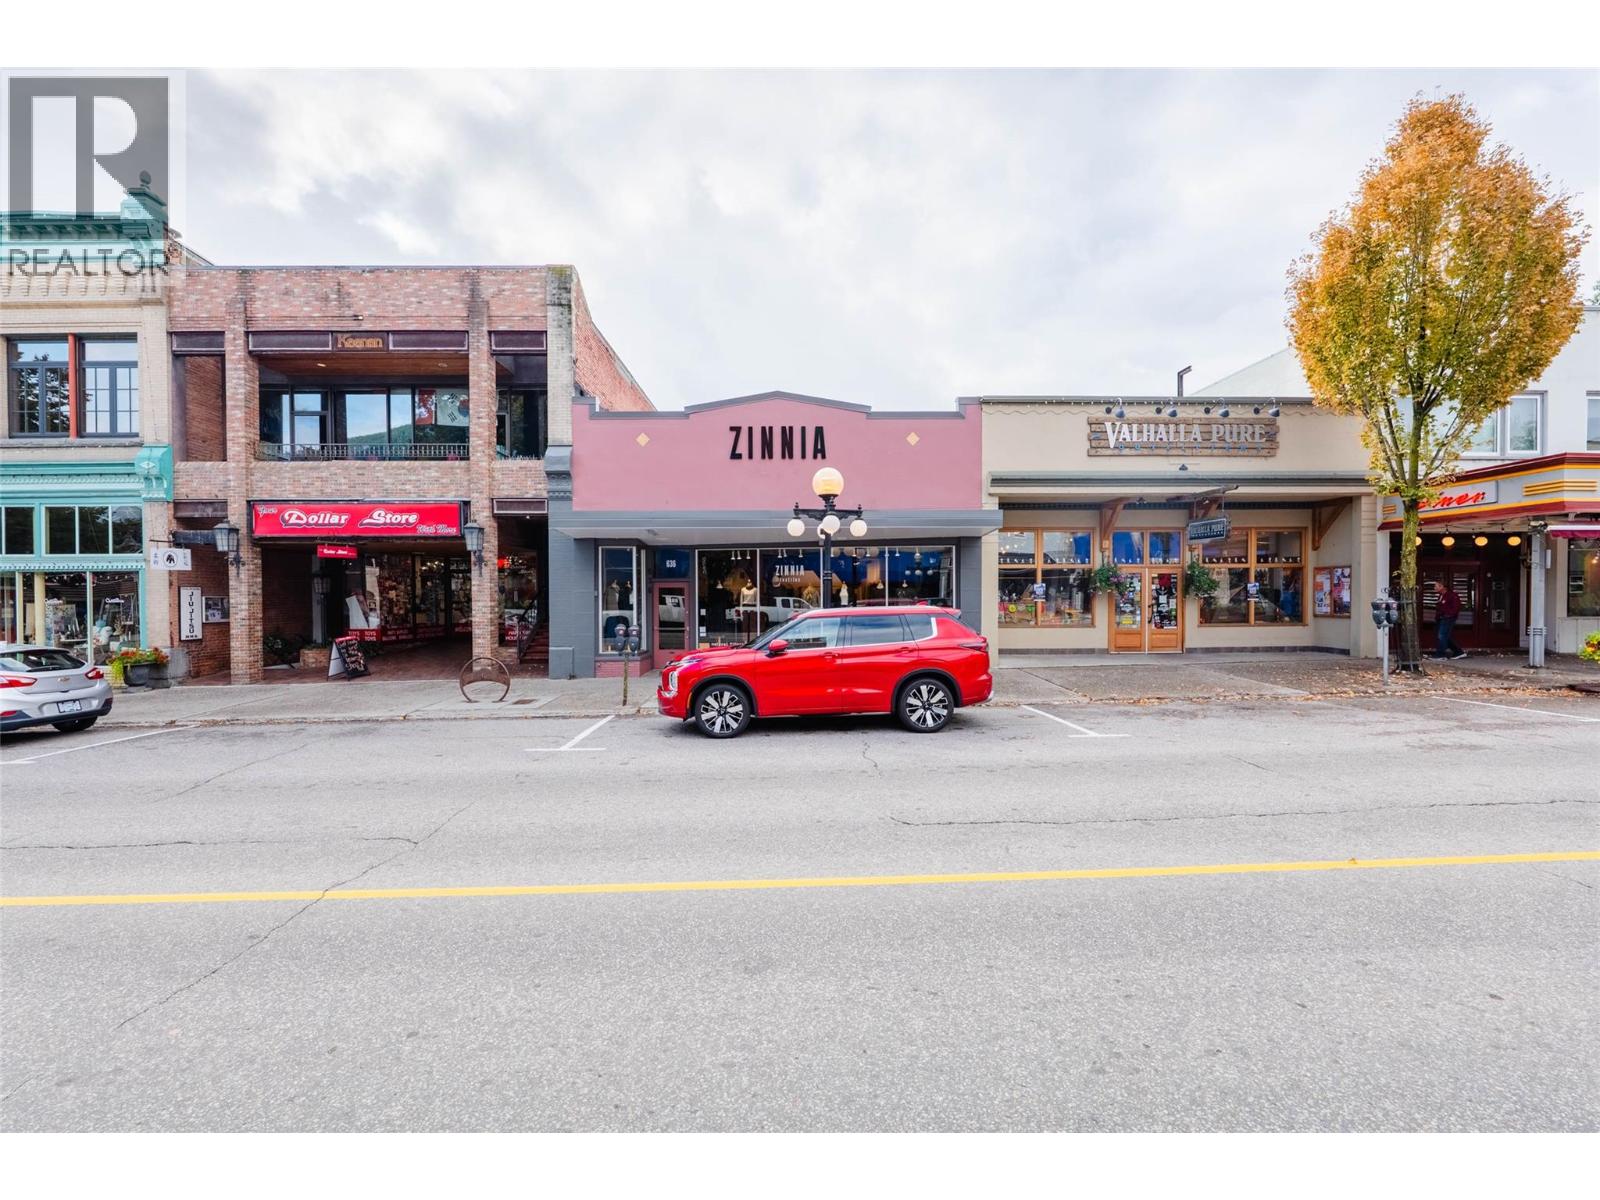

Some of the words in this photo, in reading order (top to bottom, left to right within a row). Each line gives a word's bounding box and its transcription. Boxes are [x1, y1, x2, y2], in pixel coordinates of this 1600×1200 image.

[729, 426, 827, 460] ZINNIA
[1104, 421, 1202, 449] VALHALLA
[1211, 424, 1267, 443] PURE
[281, 508, 350, 527] Dollar
[359, 508, 418, 527] Store
[775, 564, 805, 576] ZINNIA
